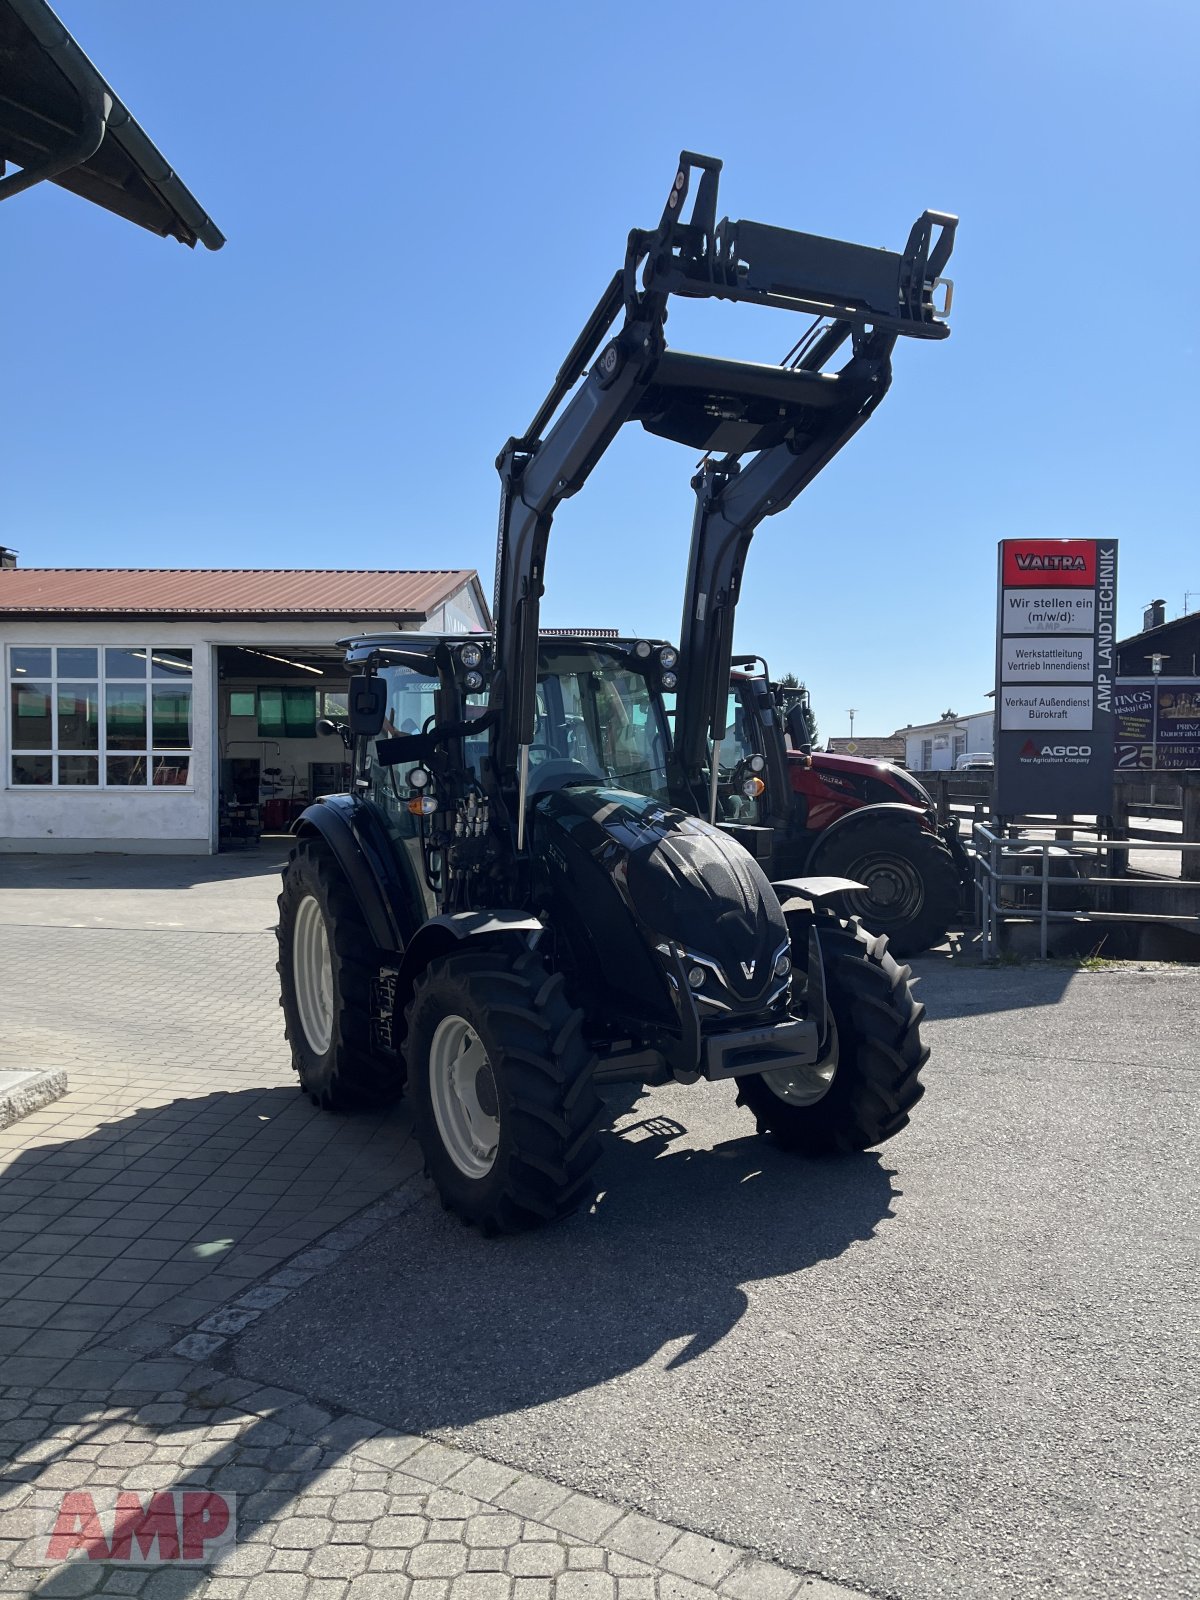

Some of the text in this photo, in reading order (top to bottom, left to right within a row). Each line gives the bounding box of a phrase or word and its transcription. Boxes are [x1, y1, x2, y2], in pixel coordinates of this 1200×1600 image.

[1015, 553, 1086, 571] VALTRA
[1010, 598, 1093, 608] Wir stellen ein
[1028, 611, 1075, 624] (m/w/d):
[1097, 548, 1114, 712] AMP LANDTECHNIK
[1015, 649, 1083, 660] Werkstattleitung
[1008, 661, 1090, 671] Vertrieb Innendienst
[1005, 697, 1090, 707] Verkauf Außendienst
[1028, 709, 1068, 719] Bürokraft
[1041, 745, 1091, 756] AGCO
